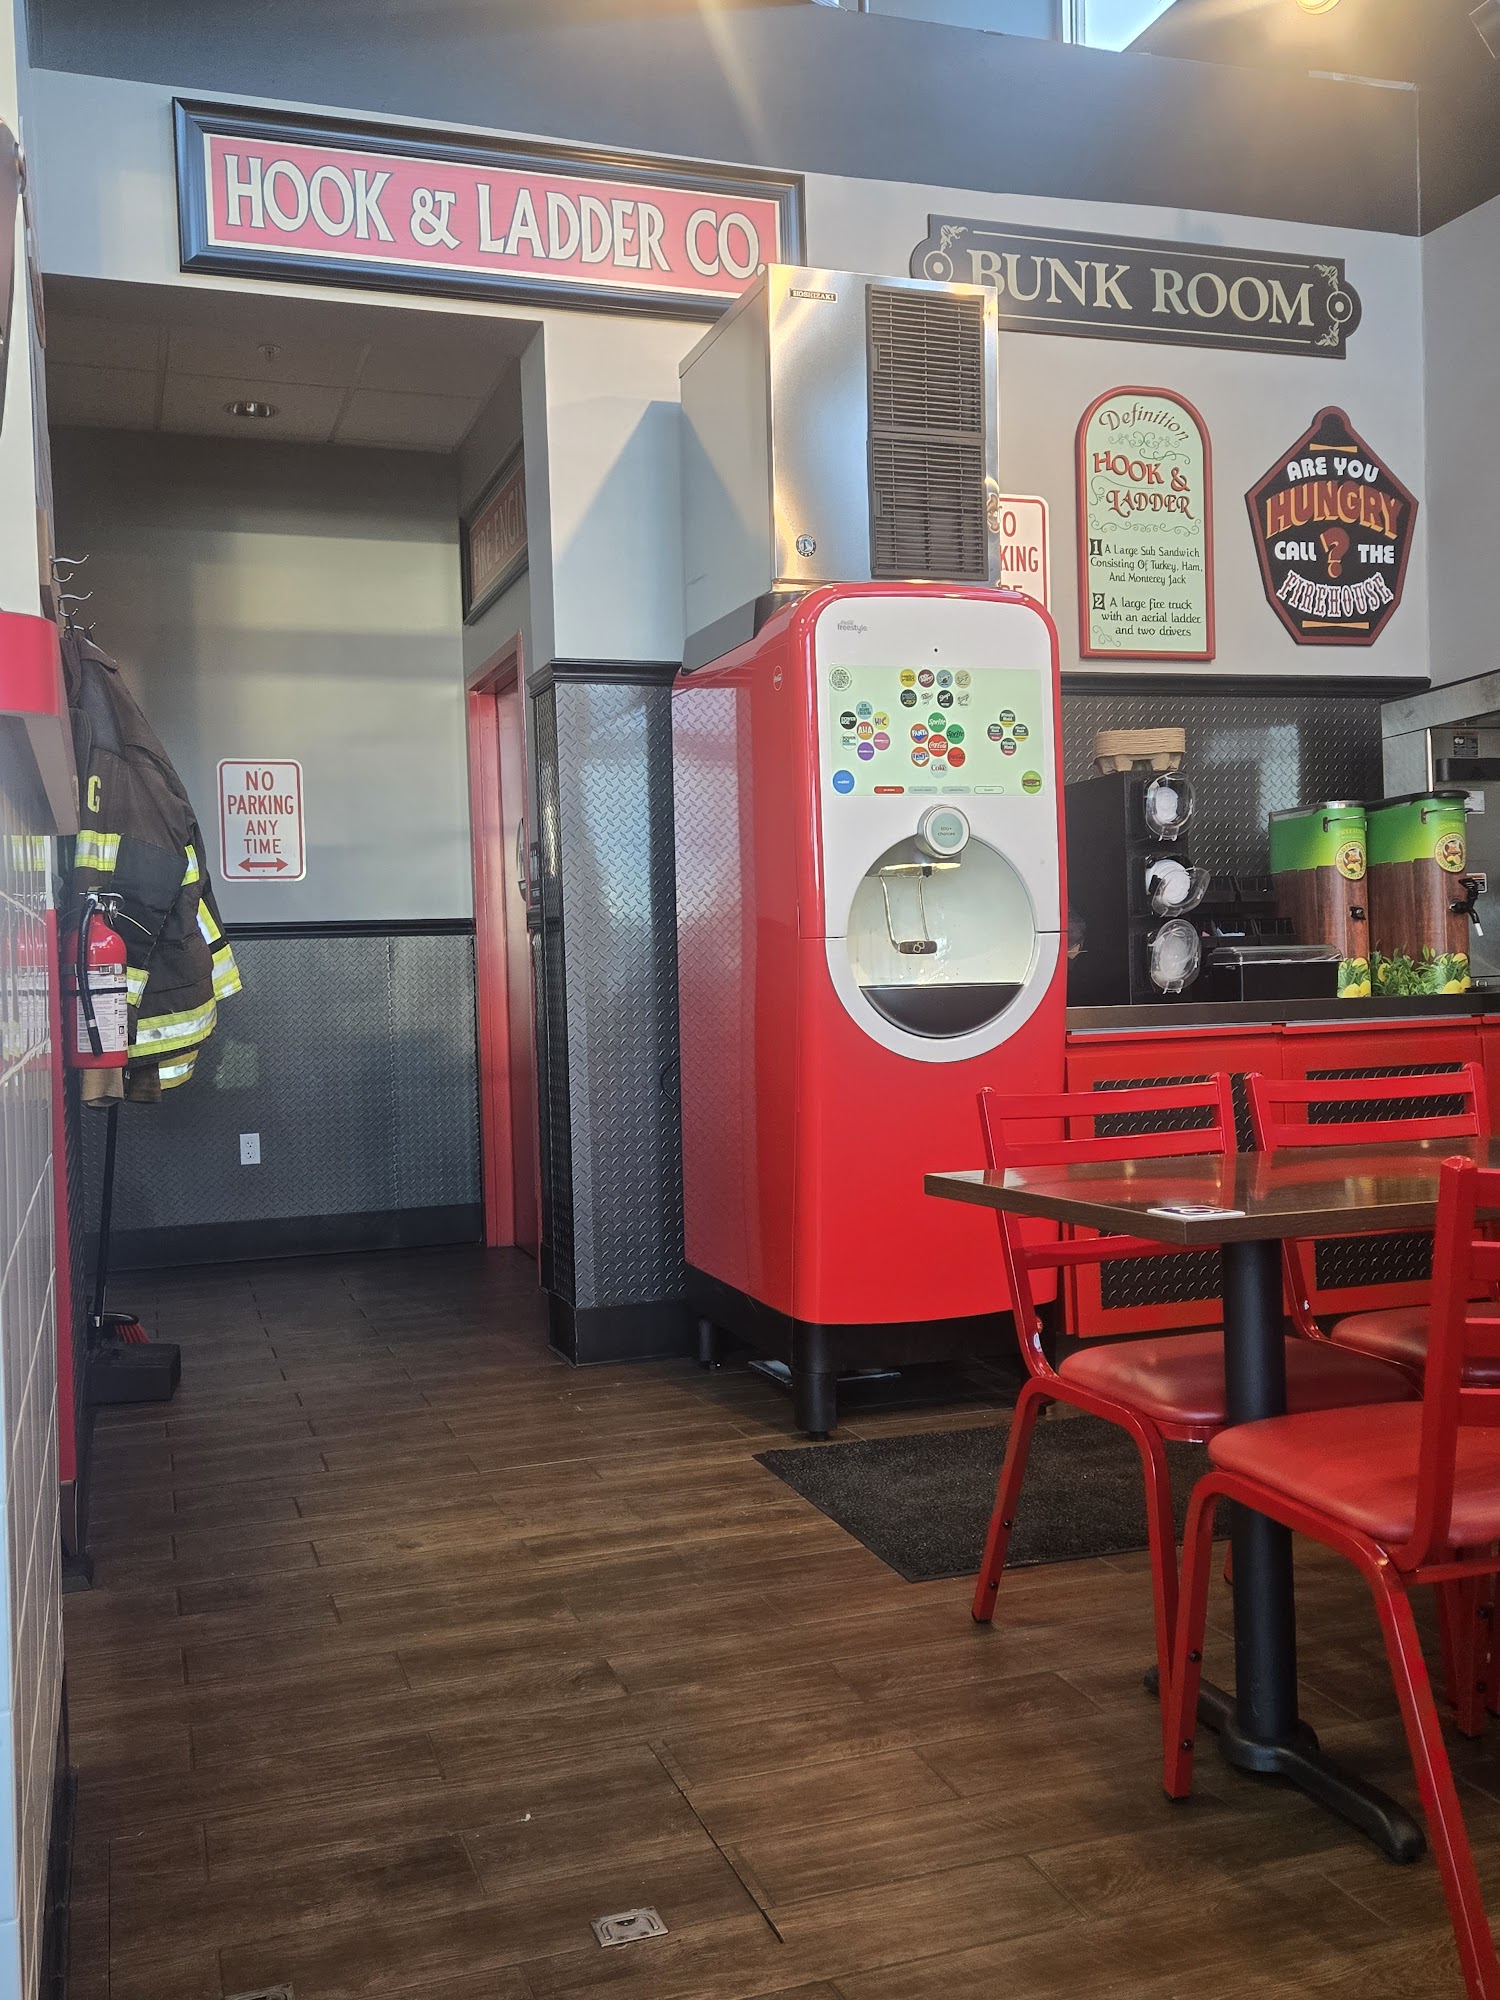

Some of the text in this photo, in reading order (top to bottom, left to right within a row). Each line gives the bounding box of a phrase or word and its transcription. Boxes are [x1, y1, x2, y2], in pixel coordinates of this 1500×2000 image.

[223, 153, 396, 243] HOOK
[410, 187, 463, 250] &
[476, 183, 673, 272] LADDER
[966, 249, 1315, 327] BUNK ROOM
[1098, 402, 1189, 441] Definition
[1092, 450, 1191, 492] HOOK &
[1286, 456, 1380, 483] ARE YOU
[1105, 489, 1195, 520] LADDER
[1265, 480, 1404, 540] HUNGRY
[1002, 510, 1017, 538] O
[1000, 545, 1039, 573] KING
[1104, 544, 1111, 554] A
[1113, 544, 1138, 557] Large
[1140, 546, 1156, 556] Sub
[1158, 547, 1200, 557] Sandwich
[1274, 541, 1317, 562] CALL
[1357, 544, 1396, 564] THE
[1090, 556, 1135, 571] Consisting
[1137, 559, 1149, 572] Of
[1181, 561, 1203, 572] Ham,
[1109, 572, 1187, 586] And Monterey Jack
[1109, 597, 1118, 607] A
[1121, 597, 1146, 611] large
[1149, 598, 1166, 611] fire
[1168, 599, 1193, 610] truck
[1275, 569, 1395, 618] FIREHOUSE
[1101, 611, 1201, 624] with an aerial ladder
[1115, 624, 1192, 637] and two drivers
[245, 770, 274, 791] NO
[227, 794, 294, 815] PARKING
[246, 820, 278, 836] ANY
[243, 838, 282, 854] TIME
